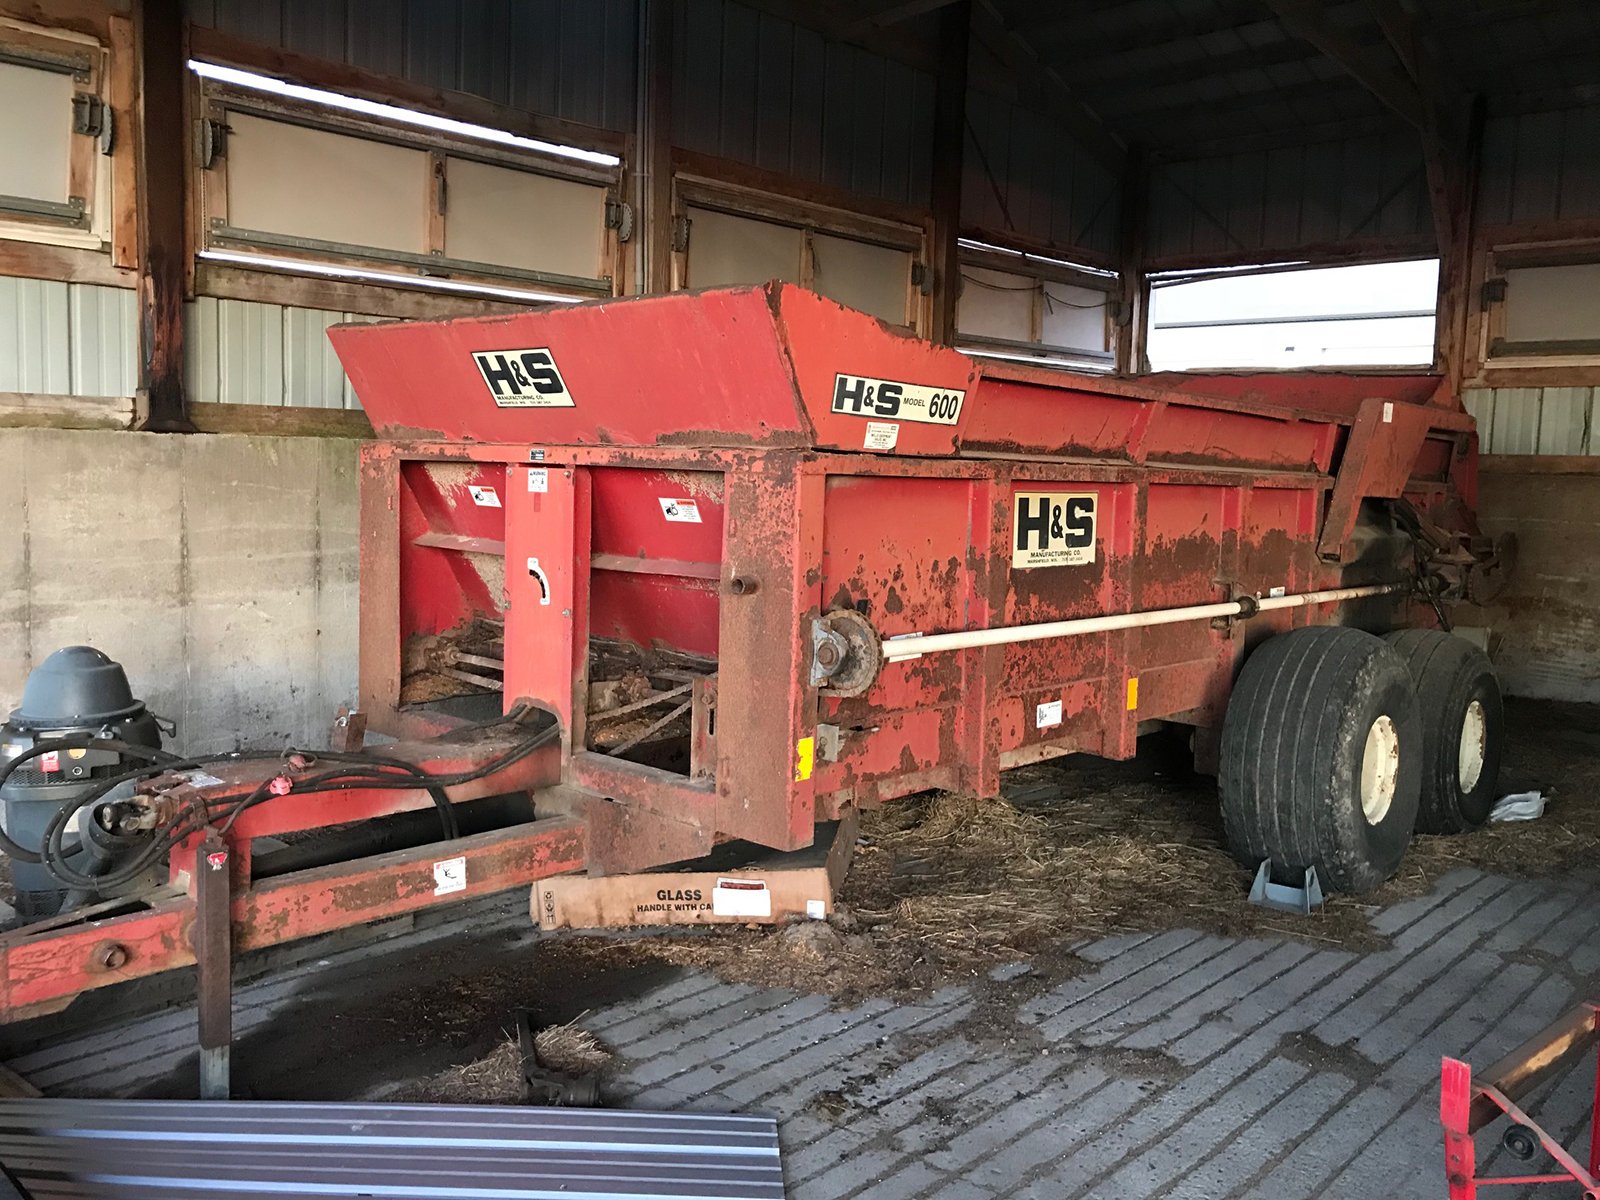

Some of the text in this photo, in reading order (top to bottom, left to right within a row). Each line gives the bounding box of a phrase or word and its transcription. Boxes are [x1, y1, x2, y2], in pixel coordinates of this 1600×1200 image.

[477, 352, 564, 395] H&S
[834, 377, 959, 420] H&S MODEL 600
[1017, 497, 1094, 550] H&S
[637, 903, 714, 912] HANDLE WITH CA
[657, 889, 702, 901] GLASS
